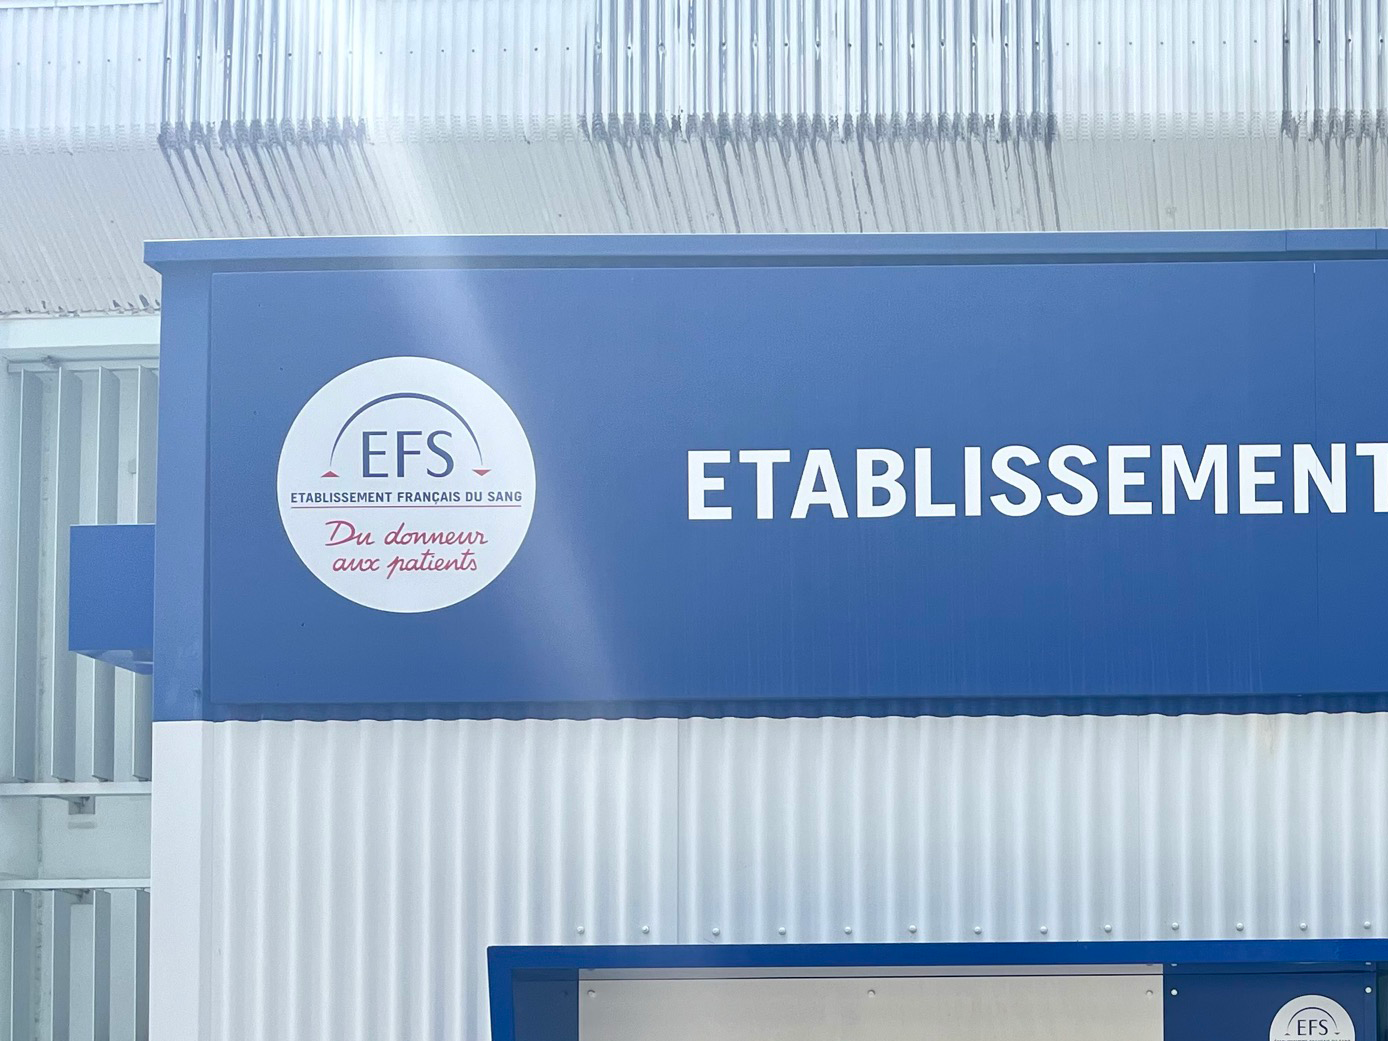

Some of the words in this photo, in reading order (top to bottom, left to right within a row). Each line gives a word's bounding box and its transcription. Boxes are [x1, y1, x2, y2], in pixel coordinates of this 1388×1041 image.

[362, 430, 455, 478] EFS
[290, 491, 393, 504] ETABLISSEMENT
[396, 491, 461, 505] FRANÇAIS
[465, 490, 483, 503] DU
[487, 490, 523, 503] SANG
[325, 520, 376, 547] Du
[383, 522, 489, 546] donneur
[332, 556, 381, 572] aux
[386, 548, 478, 580] patients
[1297, 1019, 1329, 1036] EFS
